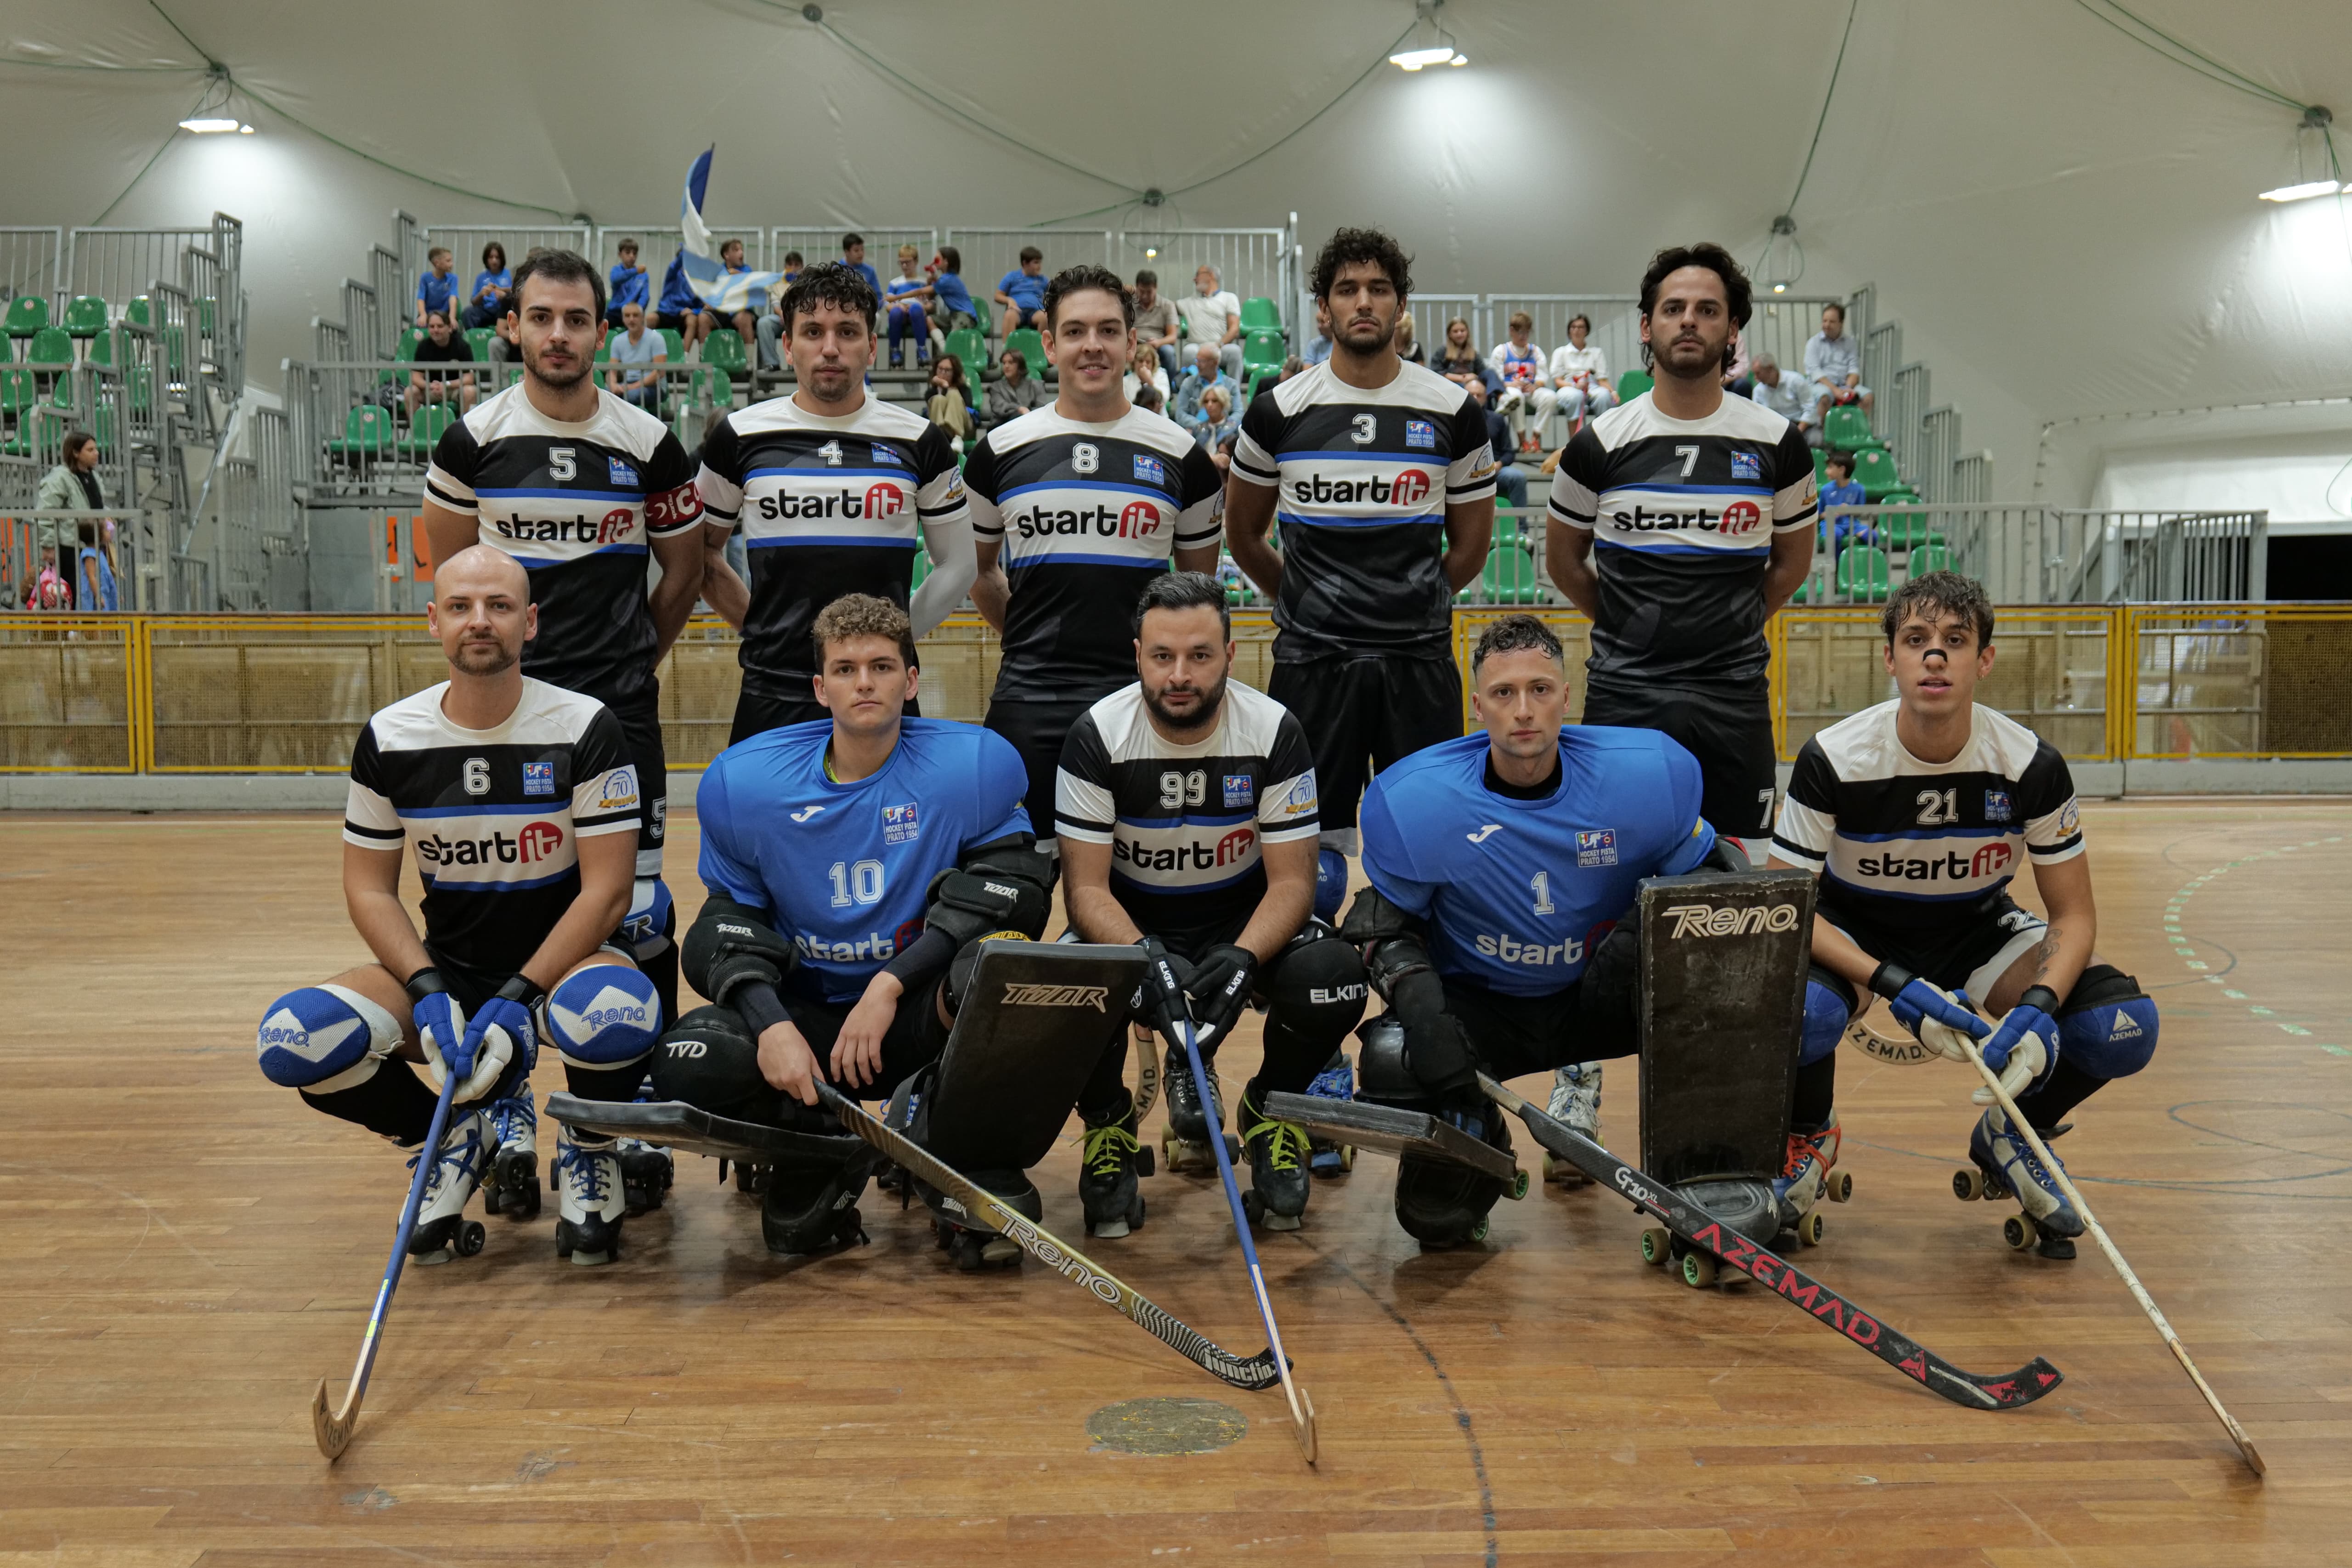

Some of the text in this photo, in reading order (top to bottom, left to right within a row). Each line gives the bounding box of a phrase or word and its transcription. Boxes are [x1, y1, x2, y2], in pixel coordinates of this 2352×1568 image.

[1351, 413, 1376, 444] 3
[549, 447, 577, 481] 5
[818, 440, 842, 464] 4
[1072, 442, 1099, 474] 8
[1675, 445, 1700, 477] 7
[1136, 466, 1152, 475] HOCKEY
[463, 757, 491, 795] 6
[1160, 769, 1207, 809] 99
[650, 797, 666, 839] 5
[1758, 788, 1775, 828] 7
[1917, 788, 1958, 825] 21
[885, 821, 917, 834] HOCKEY PISTA
[886, 829, 917, 843] PRATO 1954
[1579, 847, 1615, 858] HOCKEY PISTA
[1580, 855, 1616, 866] PRATO 1954
[829, 859, 884, 907] 10
[1531, 871, 1555, 915] 1
[1159, 961, 1176, 990] ELKING
[1225, 969, 1245, 996] ELKING
[2109, 1028, 2143, 1042] AZEMAD
[1647, 1192, 1658, 1204] XL
